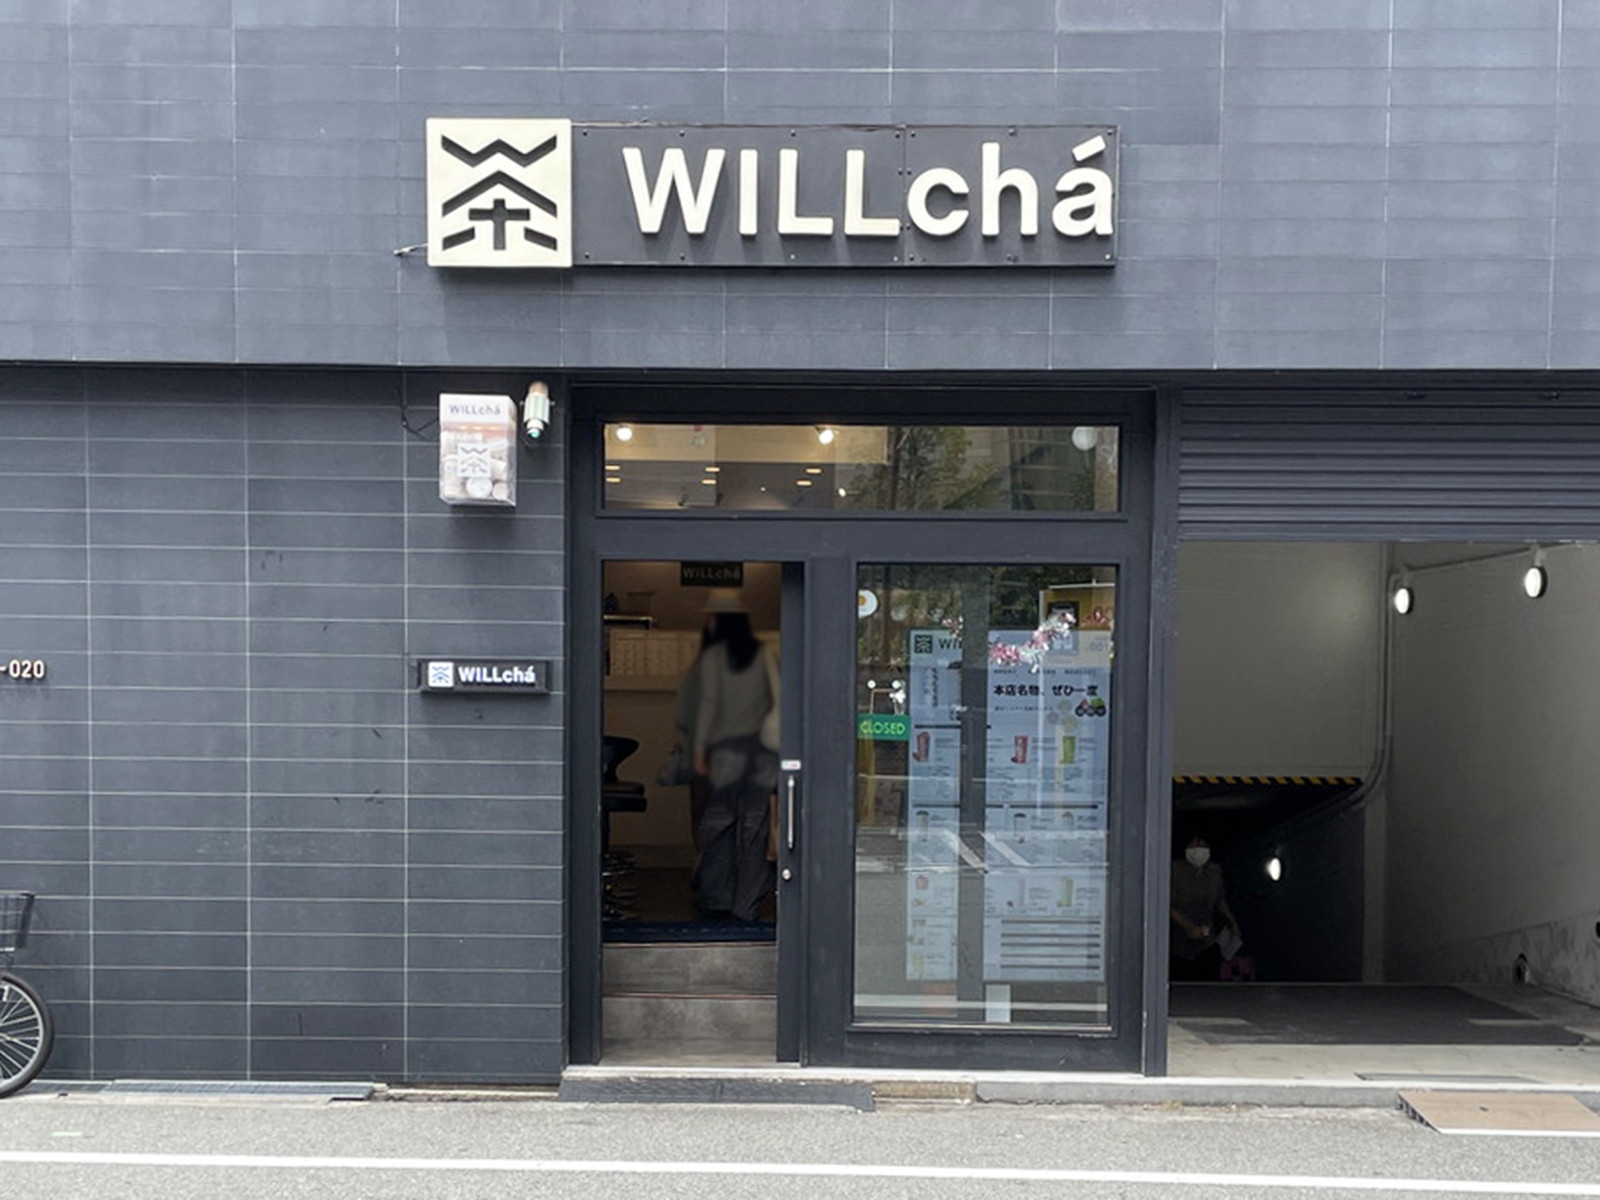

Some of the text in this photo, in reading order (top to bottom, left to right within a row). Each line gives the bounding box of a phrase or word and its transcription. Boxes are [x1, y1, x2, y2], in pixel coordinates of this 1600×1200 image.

[622, 135, 1113, 236] WILLchá
[458, 665, 536, 683] WILLchá
[860, 720, 906, 735] CLOSED
